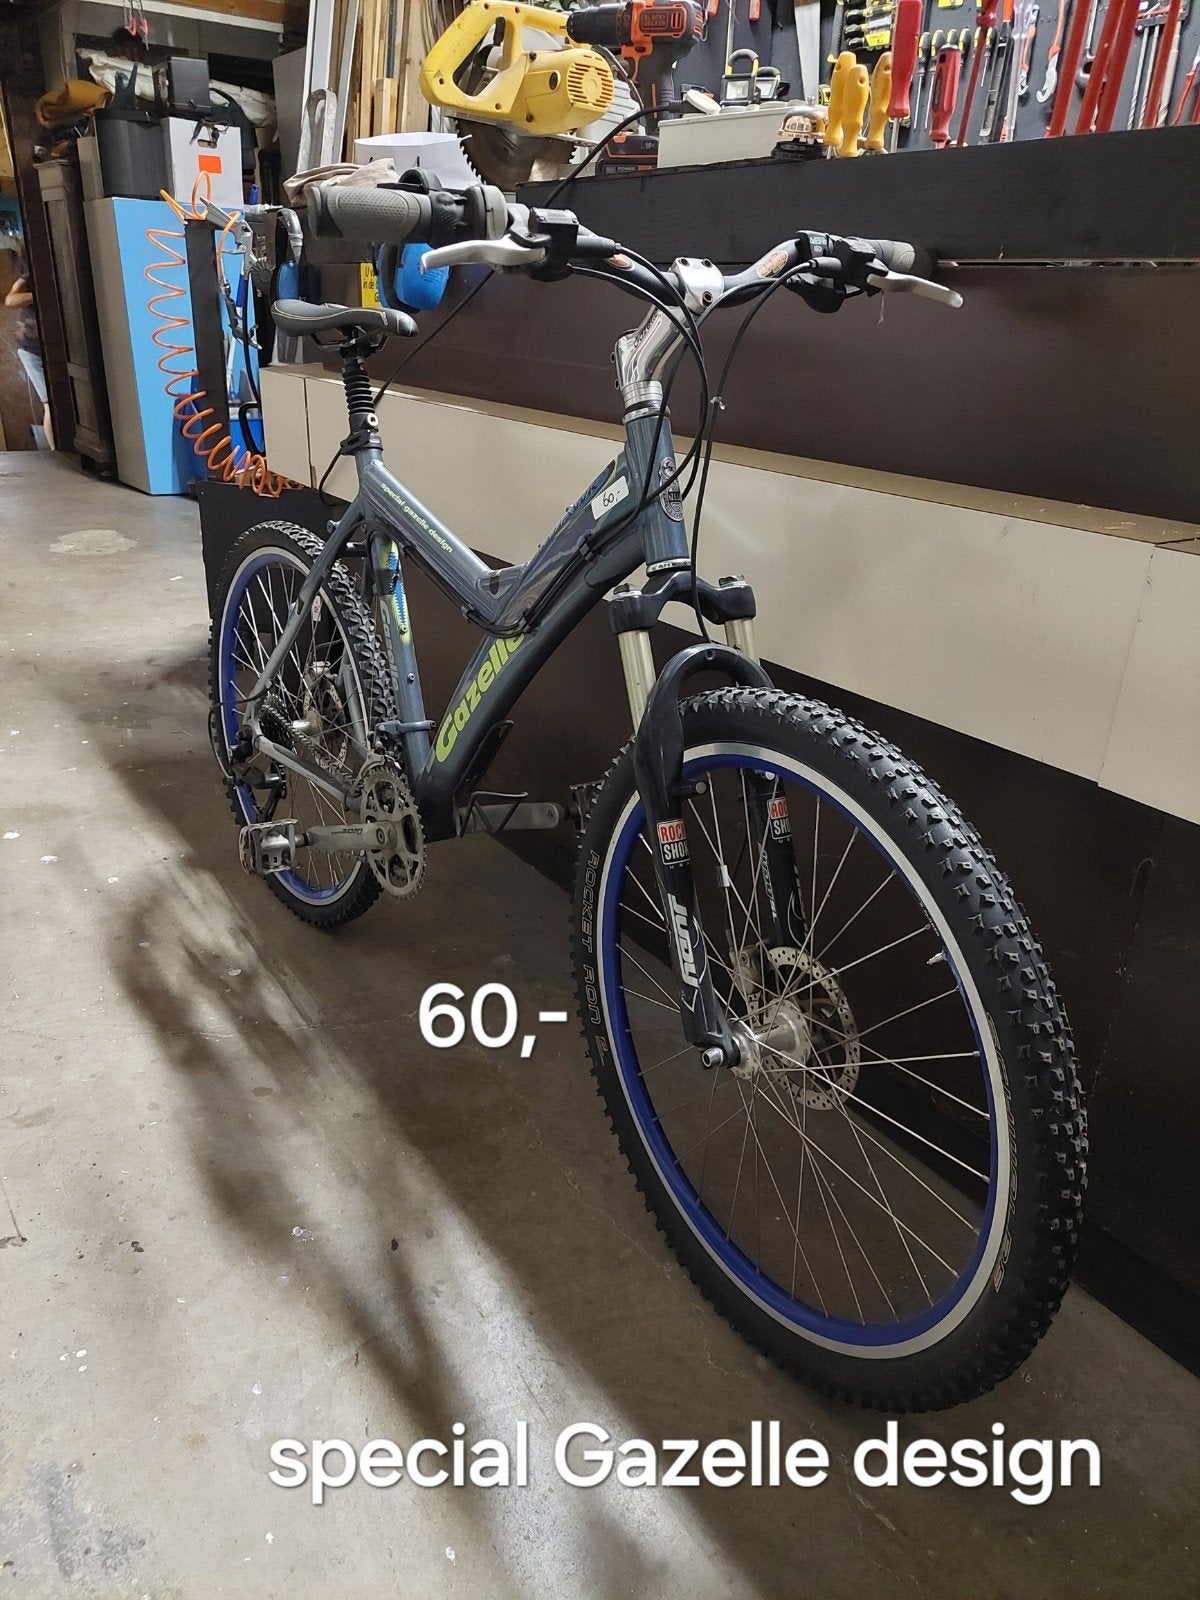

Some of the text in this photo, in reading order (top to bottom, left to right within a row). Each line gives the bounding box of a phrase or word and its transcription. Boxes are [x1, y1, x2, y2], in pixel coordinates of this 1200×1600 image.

[381, 483, 454, 553] special gazelle design
[435, 620, 526, 763] Gazelle
[581, 849, 601, 1025] ROCKET RON
